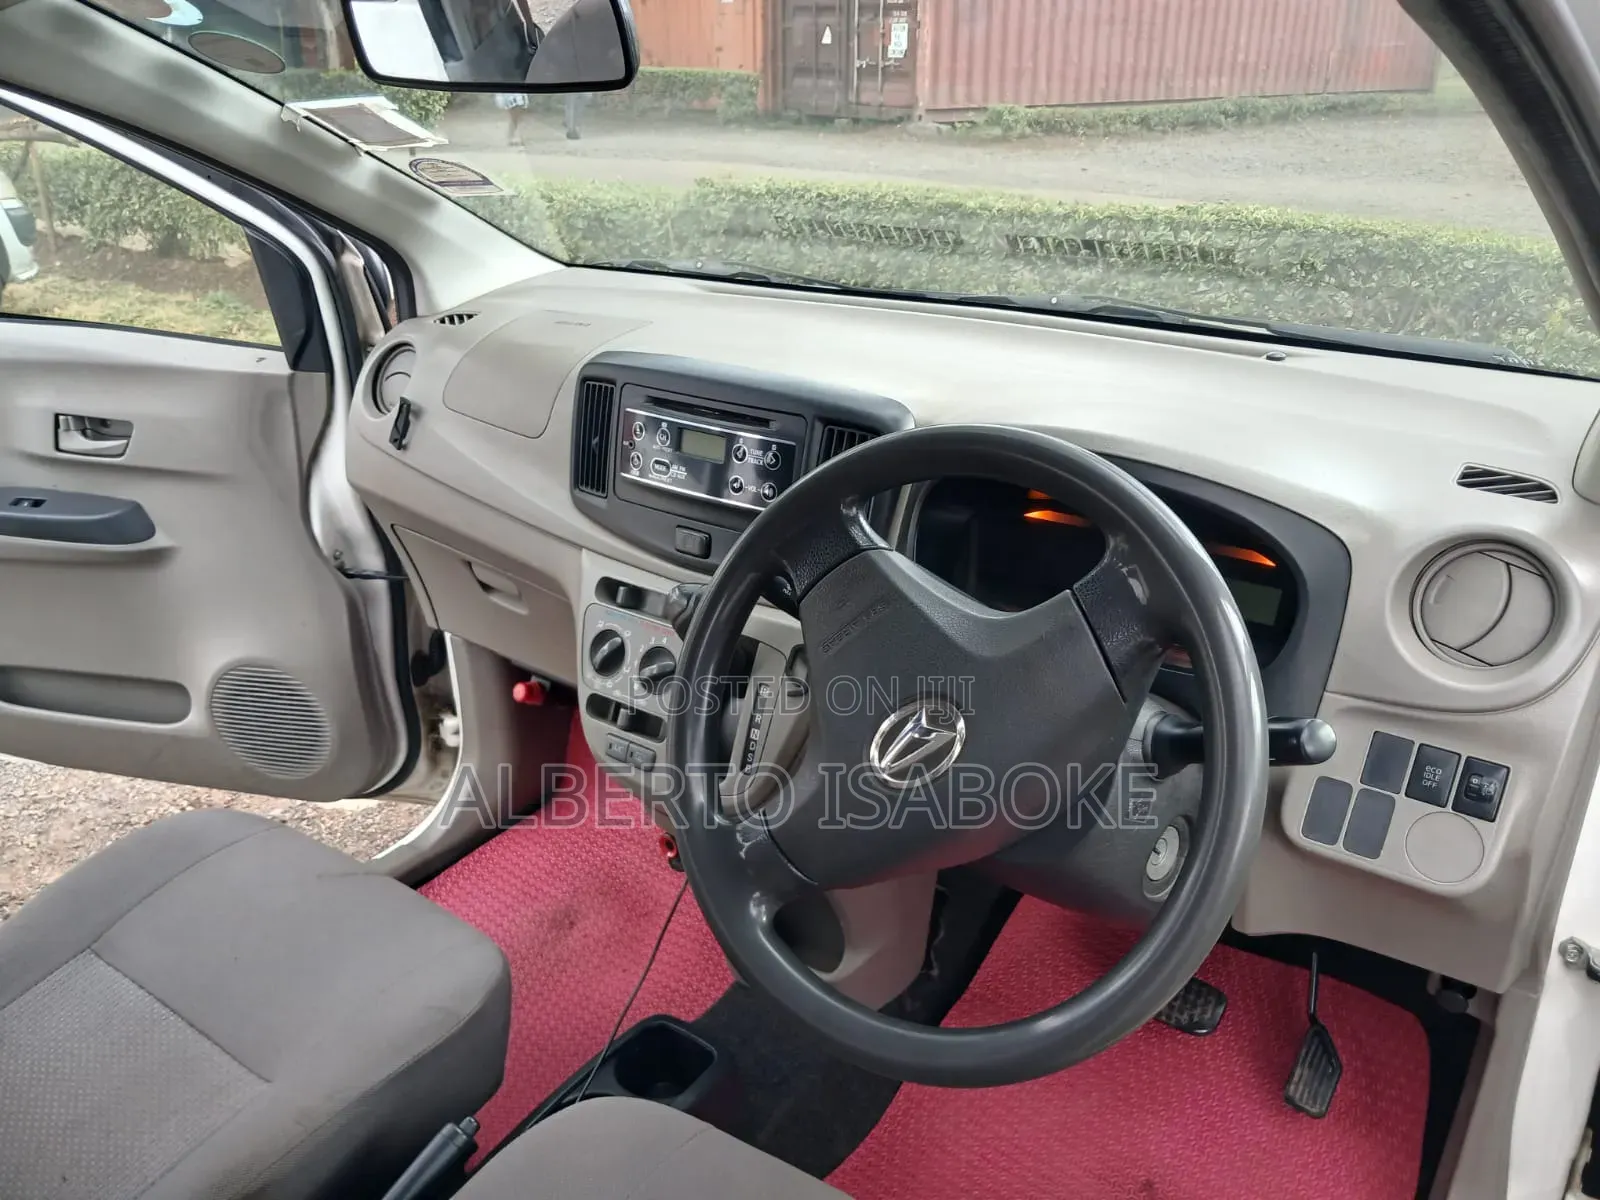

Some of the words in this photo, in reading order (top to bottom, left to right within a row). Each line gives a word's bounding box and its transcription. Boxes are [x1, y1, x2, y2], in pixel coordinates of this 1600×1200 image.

[1425, 765, 1442, 774] eco
[1423, 772, 1441, 781] IDLE
[1422, 780, 1438, 788] OFF
